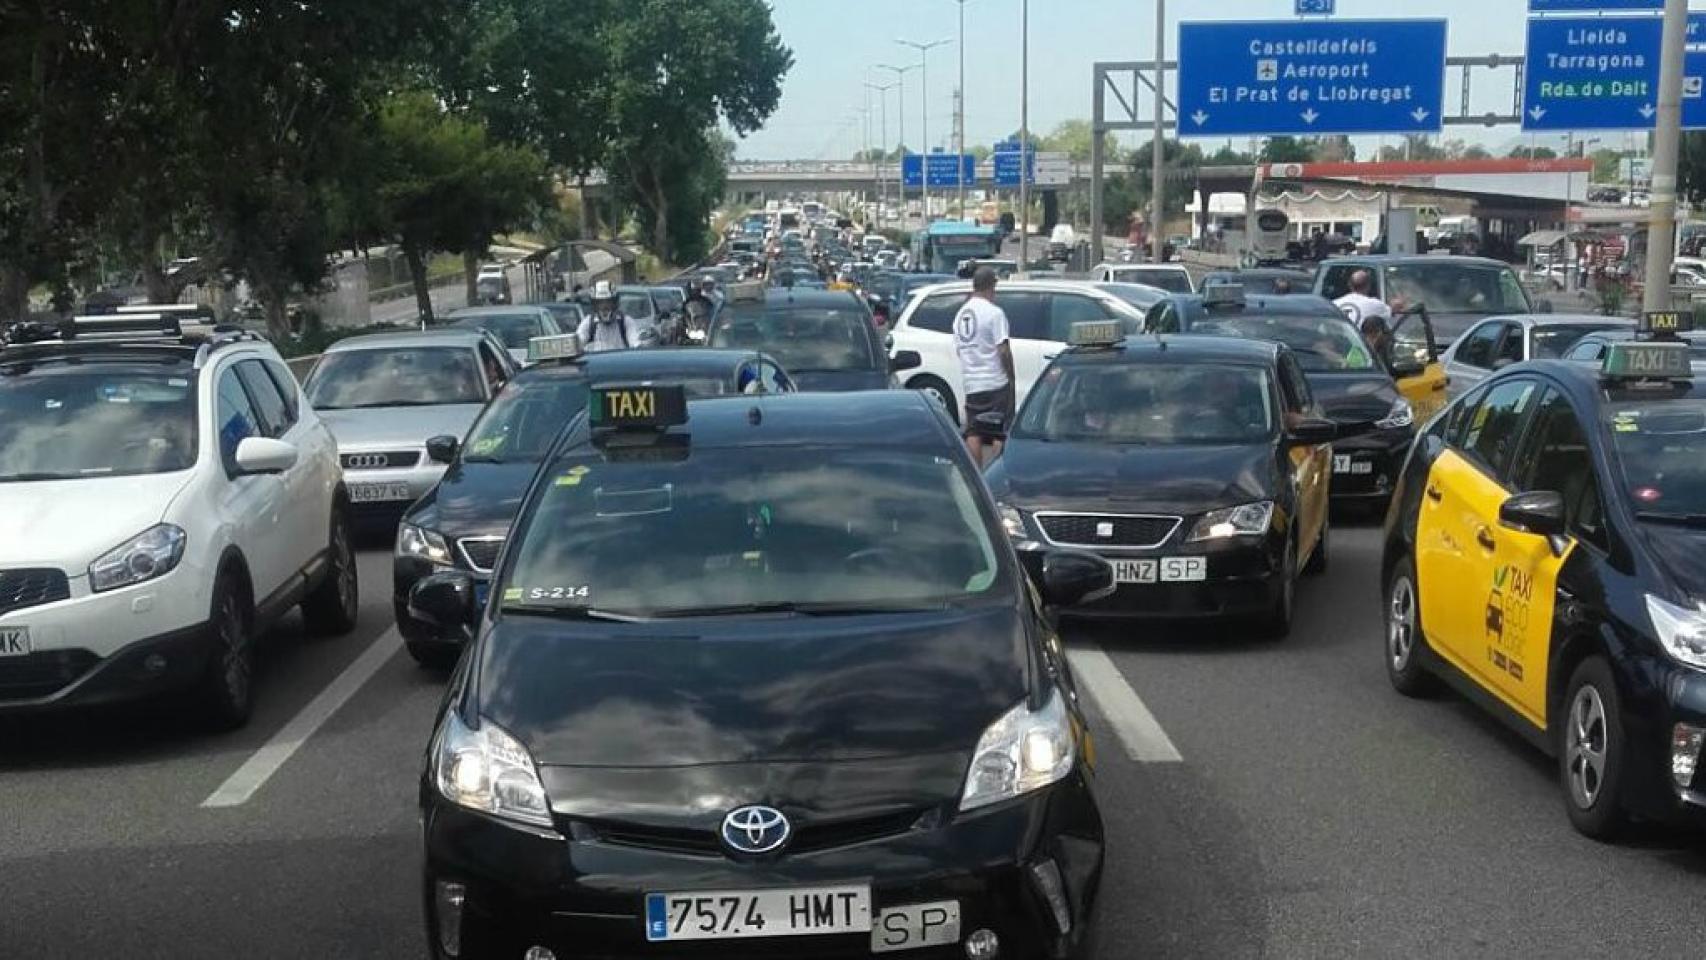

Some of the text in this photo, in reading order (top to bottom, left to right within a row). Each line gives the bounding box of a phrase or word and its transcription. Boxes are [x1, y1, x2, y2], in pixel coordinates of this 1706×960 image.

[1567, 28, 1627, 45] Lleida
[1250, 39, 1377, 55] Castelldefels
[1283, 61, 1369, 80] Aeroport
[1547, 53, 1645, 72] Tarragona
[1209, 84, 1411, 104] El Prat de Llobregat
[1581, 81, 1603, 96] de
[1611, 80, 1647, 96] Dalt
[1649, 313, 1677, 328] TAXI
[1627, 349, 1664, 369] TAXI
[605, 391, 655, 418] TAXI
[1116, 562, 1153, 580] HNZ
[1168, 560, 1199, 578] SP
[530, 585, 589, 599] S-214
[1511, 565, 1533, 602] TAXI
[671, 892, 858, 934] 7574 HMT
